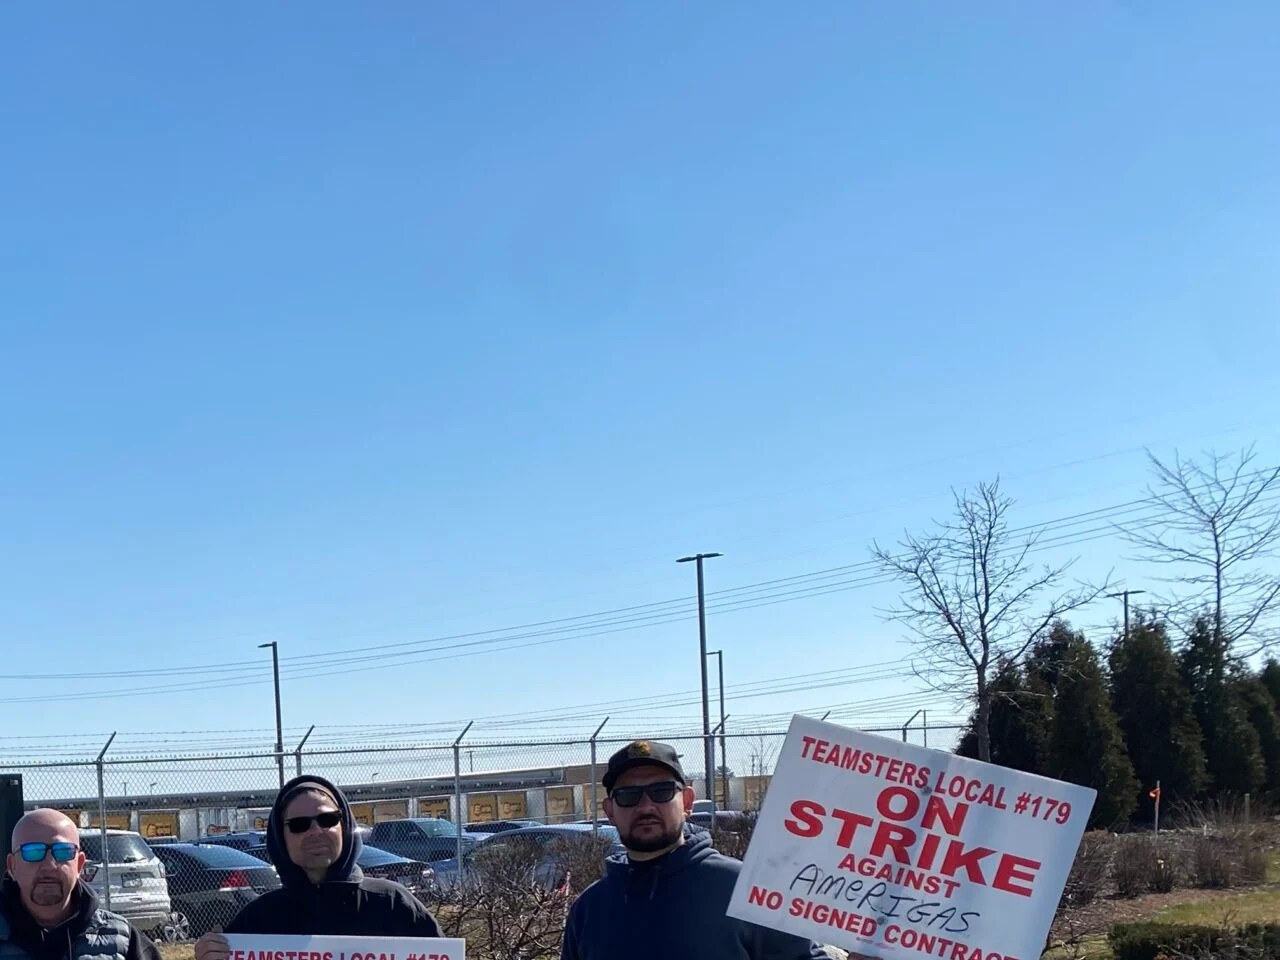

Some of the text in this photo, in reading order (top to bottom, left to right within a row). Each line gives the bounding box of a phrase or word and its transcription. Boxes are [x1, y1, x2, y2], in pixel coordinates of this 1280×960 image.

[801, 735, 1072, 825] TEAMSTERS LOCAL #179
[876, 785, 970, 837] ON
[784, 799, 1042, 898] STRIKE
[837, 853, 961, 899] AGAINST
[748, 885, 784, 911] NO
[788, 897, 879, 938] SIGNED
